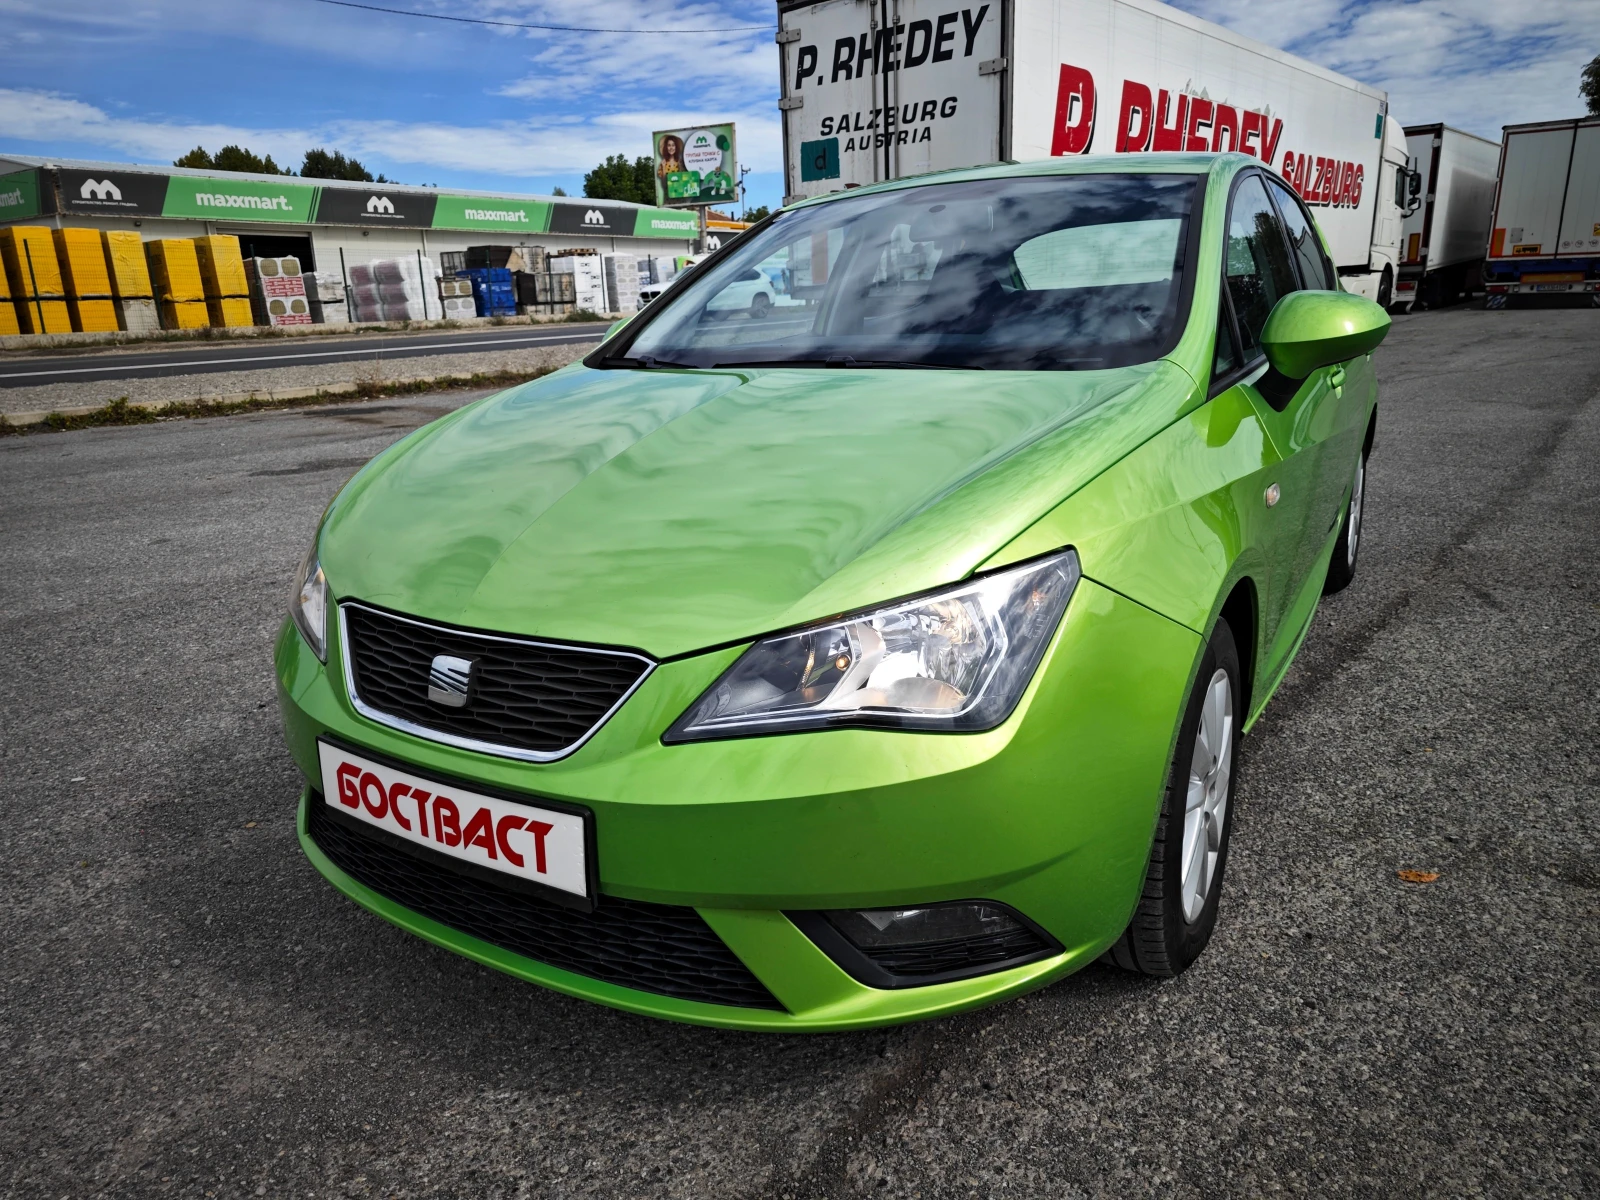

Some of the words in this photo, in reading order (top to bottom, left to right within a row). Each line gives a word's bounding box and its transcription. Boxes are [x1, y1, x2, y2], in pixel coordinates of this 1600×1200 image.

[820, 96, 958, 136] SALZBURG
[844, 126, 932, 153] AUSTRIA
[1282, 150, 1364, 210] SALZBURG
[336, 761, 554, 875] БОСТВАСТ
